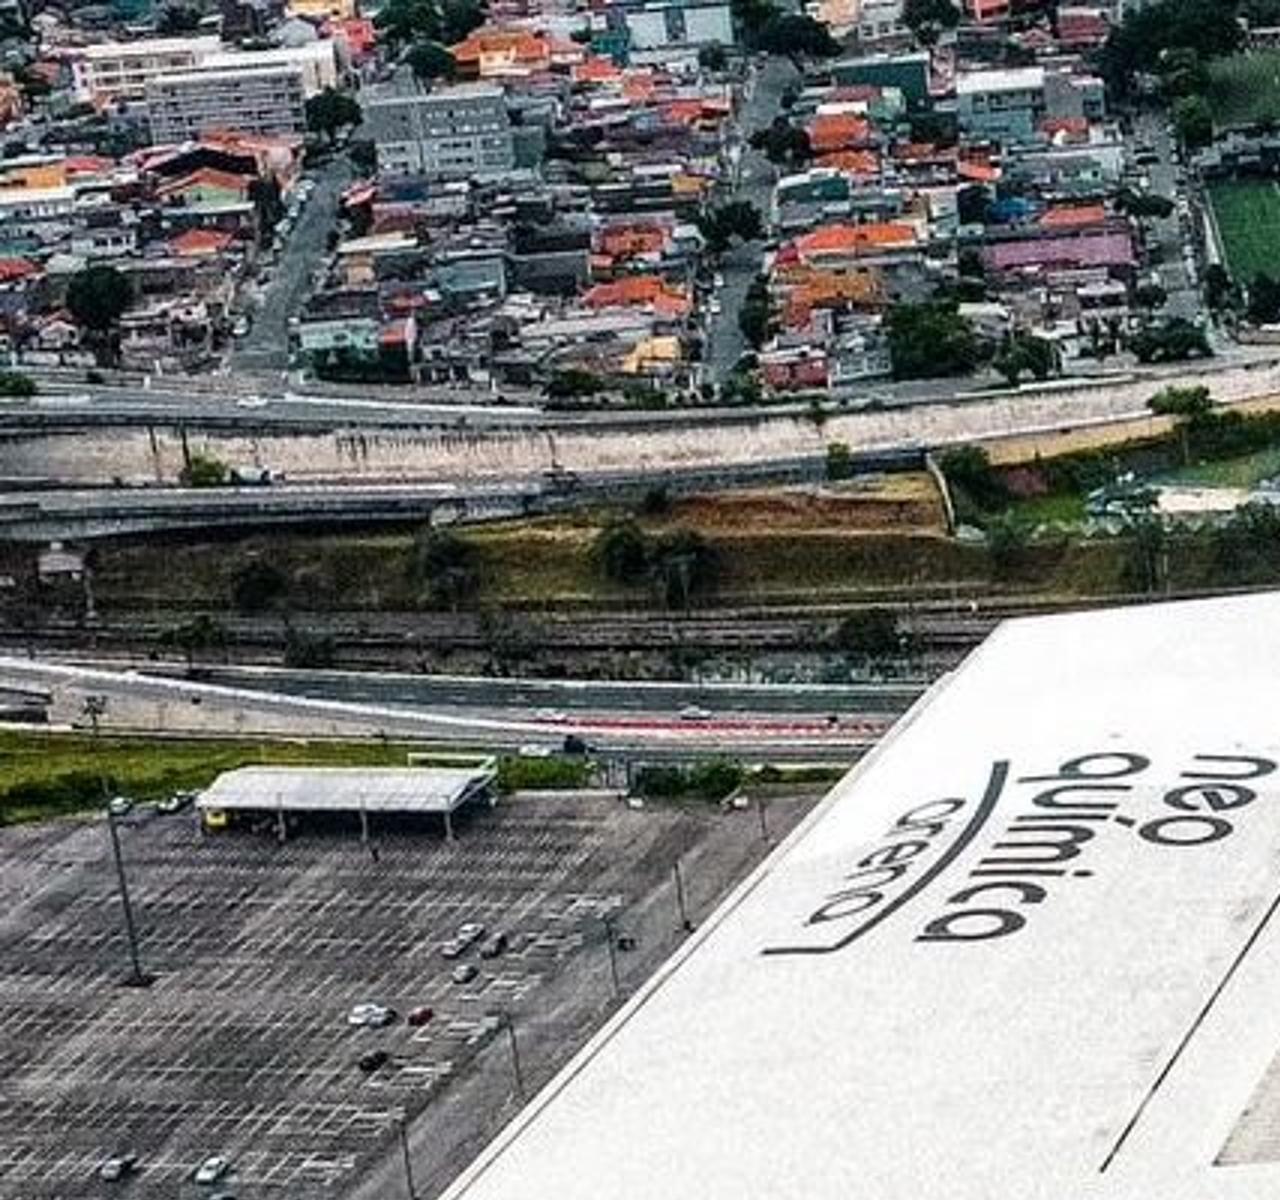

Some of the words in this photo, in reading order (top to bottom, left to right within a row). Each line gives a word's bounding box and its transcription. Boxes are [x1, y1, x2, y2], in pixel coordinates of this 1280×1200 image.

[802, 797, 967, 927] arena
[913, 752, 1151, 942] química
[1136, 754, 1277, 847] neo
